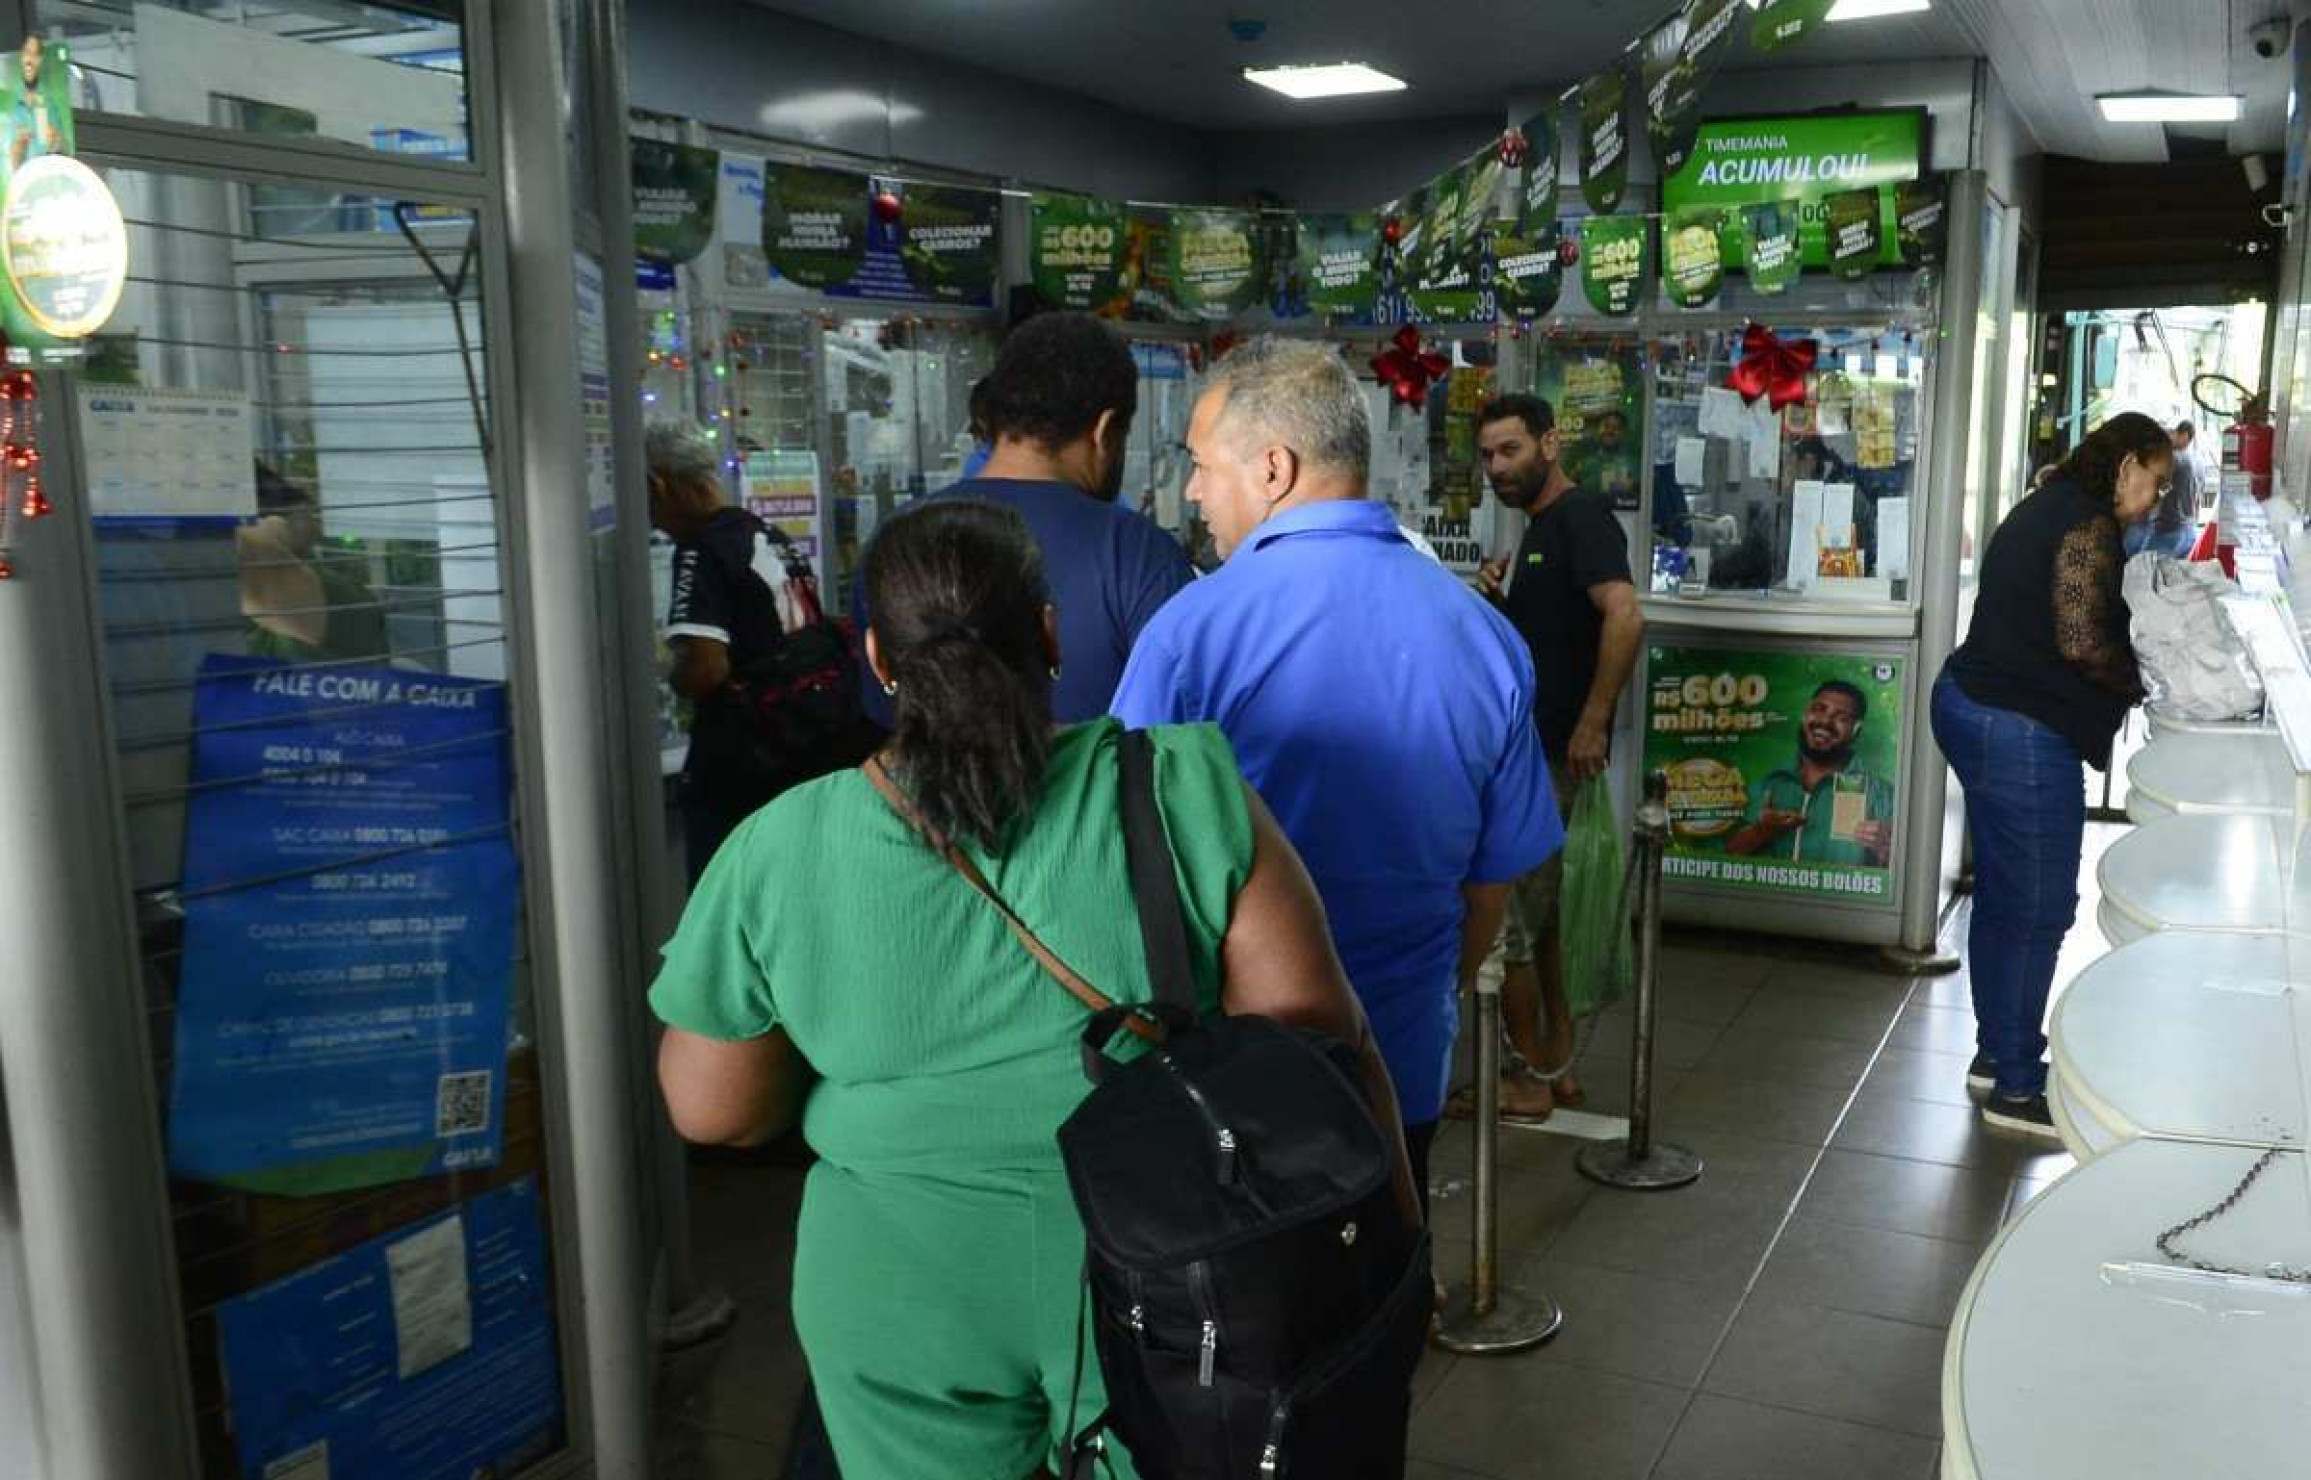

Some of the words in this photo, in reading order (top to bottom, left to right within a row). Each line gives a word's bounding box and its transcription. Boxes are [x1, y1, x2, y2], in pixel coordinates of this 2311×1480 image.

[1706, 135, 1786, 154] TIMEMANIA
[1698, 154, 1868, 187] ACUMULOU!
[1061, 223, 1114, 249] 600
[253, 673, 314, 698] FALE
[317, 675, 381, 703] COM
[384, 683, 402, 704] A
[1682, 673, 1770, 706] 600
[1652, 708, 1766, 732] milhões
[1663, 857, 1719, 879] RTICIPE
[1756, 865, 1819, 889] NOSSOS
